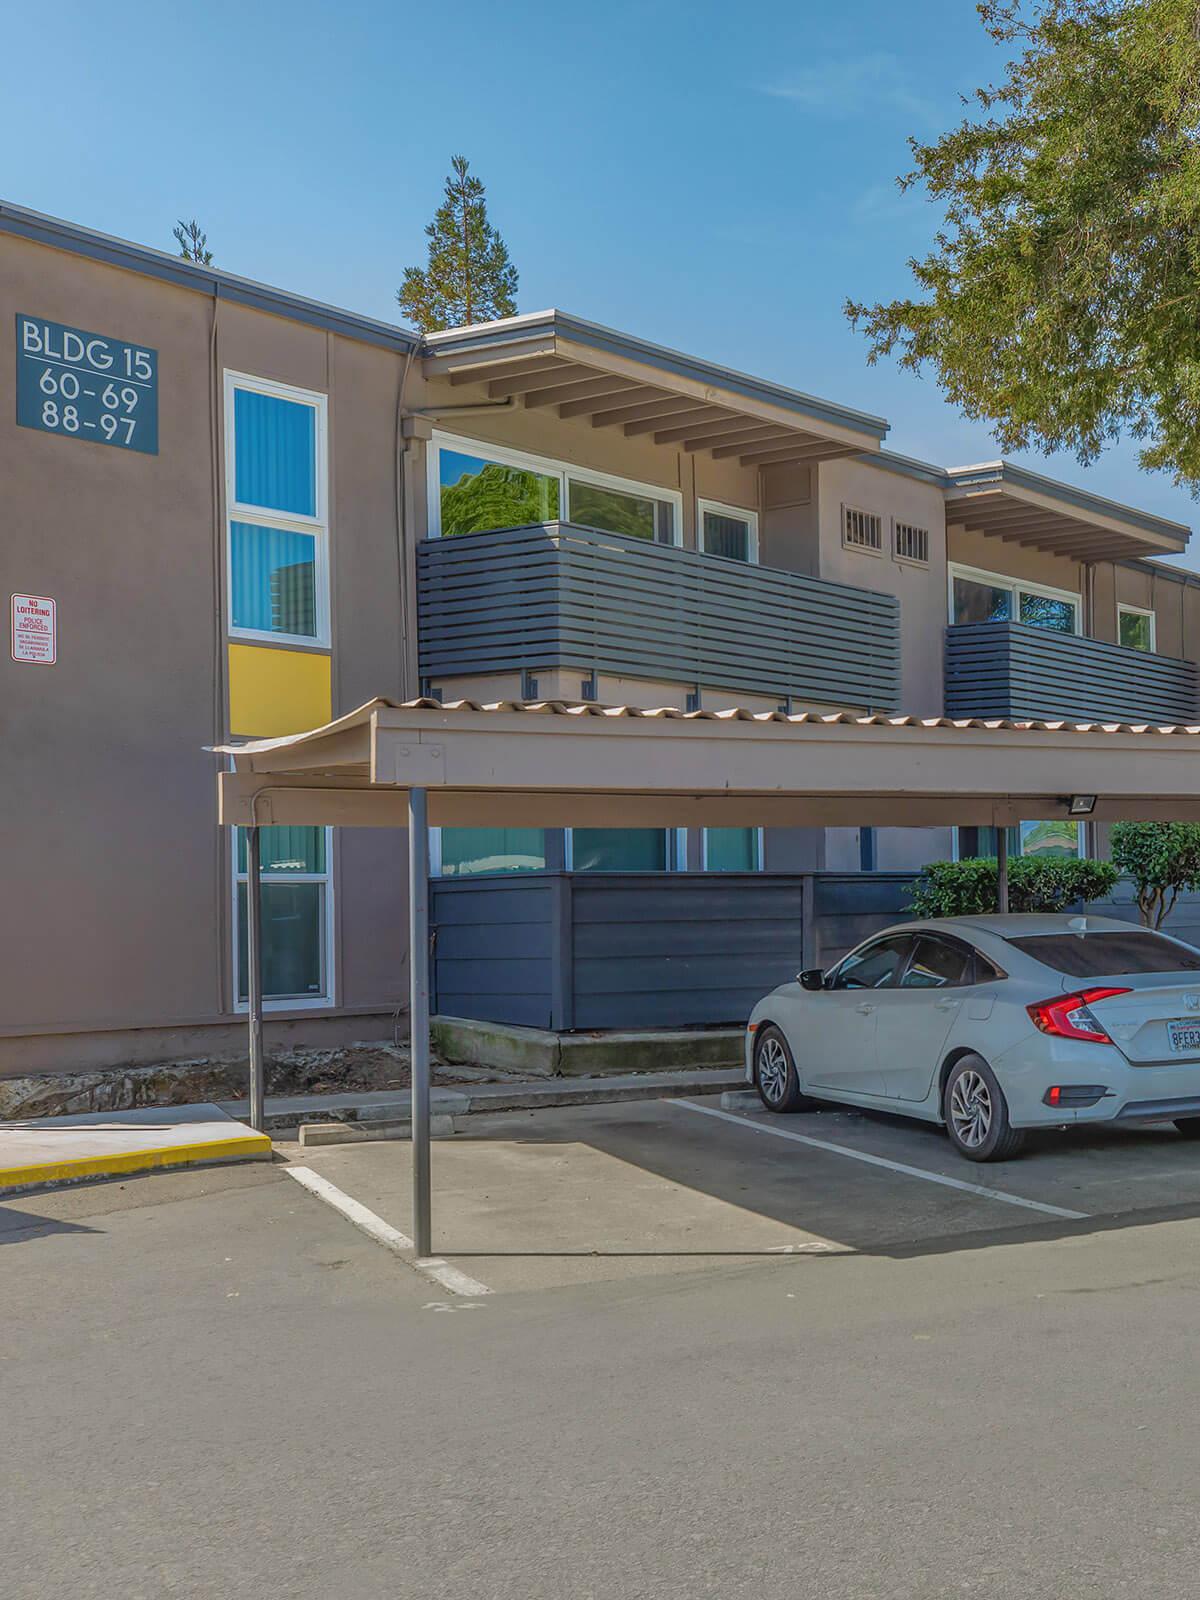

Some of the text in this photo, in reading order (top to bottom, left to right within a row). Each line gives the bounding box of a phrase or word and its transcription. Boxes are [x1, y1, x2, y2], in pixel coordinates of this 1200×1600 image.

[23, 321, 152, 380] BLDG 15
[39, 368, 138, 413] 60-69
[42, 400, 137, 444] 88-97
[16, 606, 50, 616] LOITERING
[19, 623, 48, 631] ENFORCED
